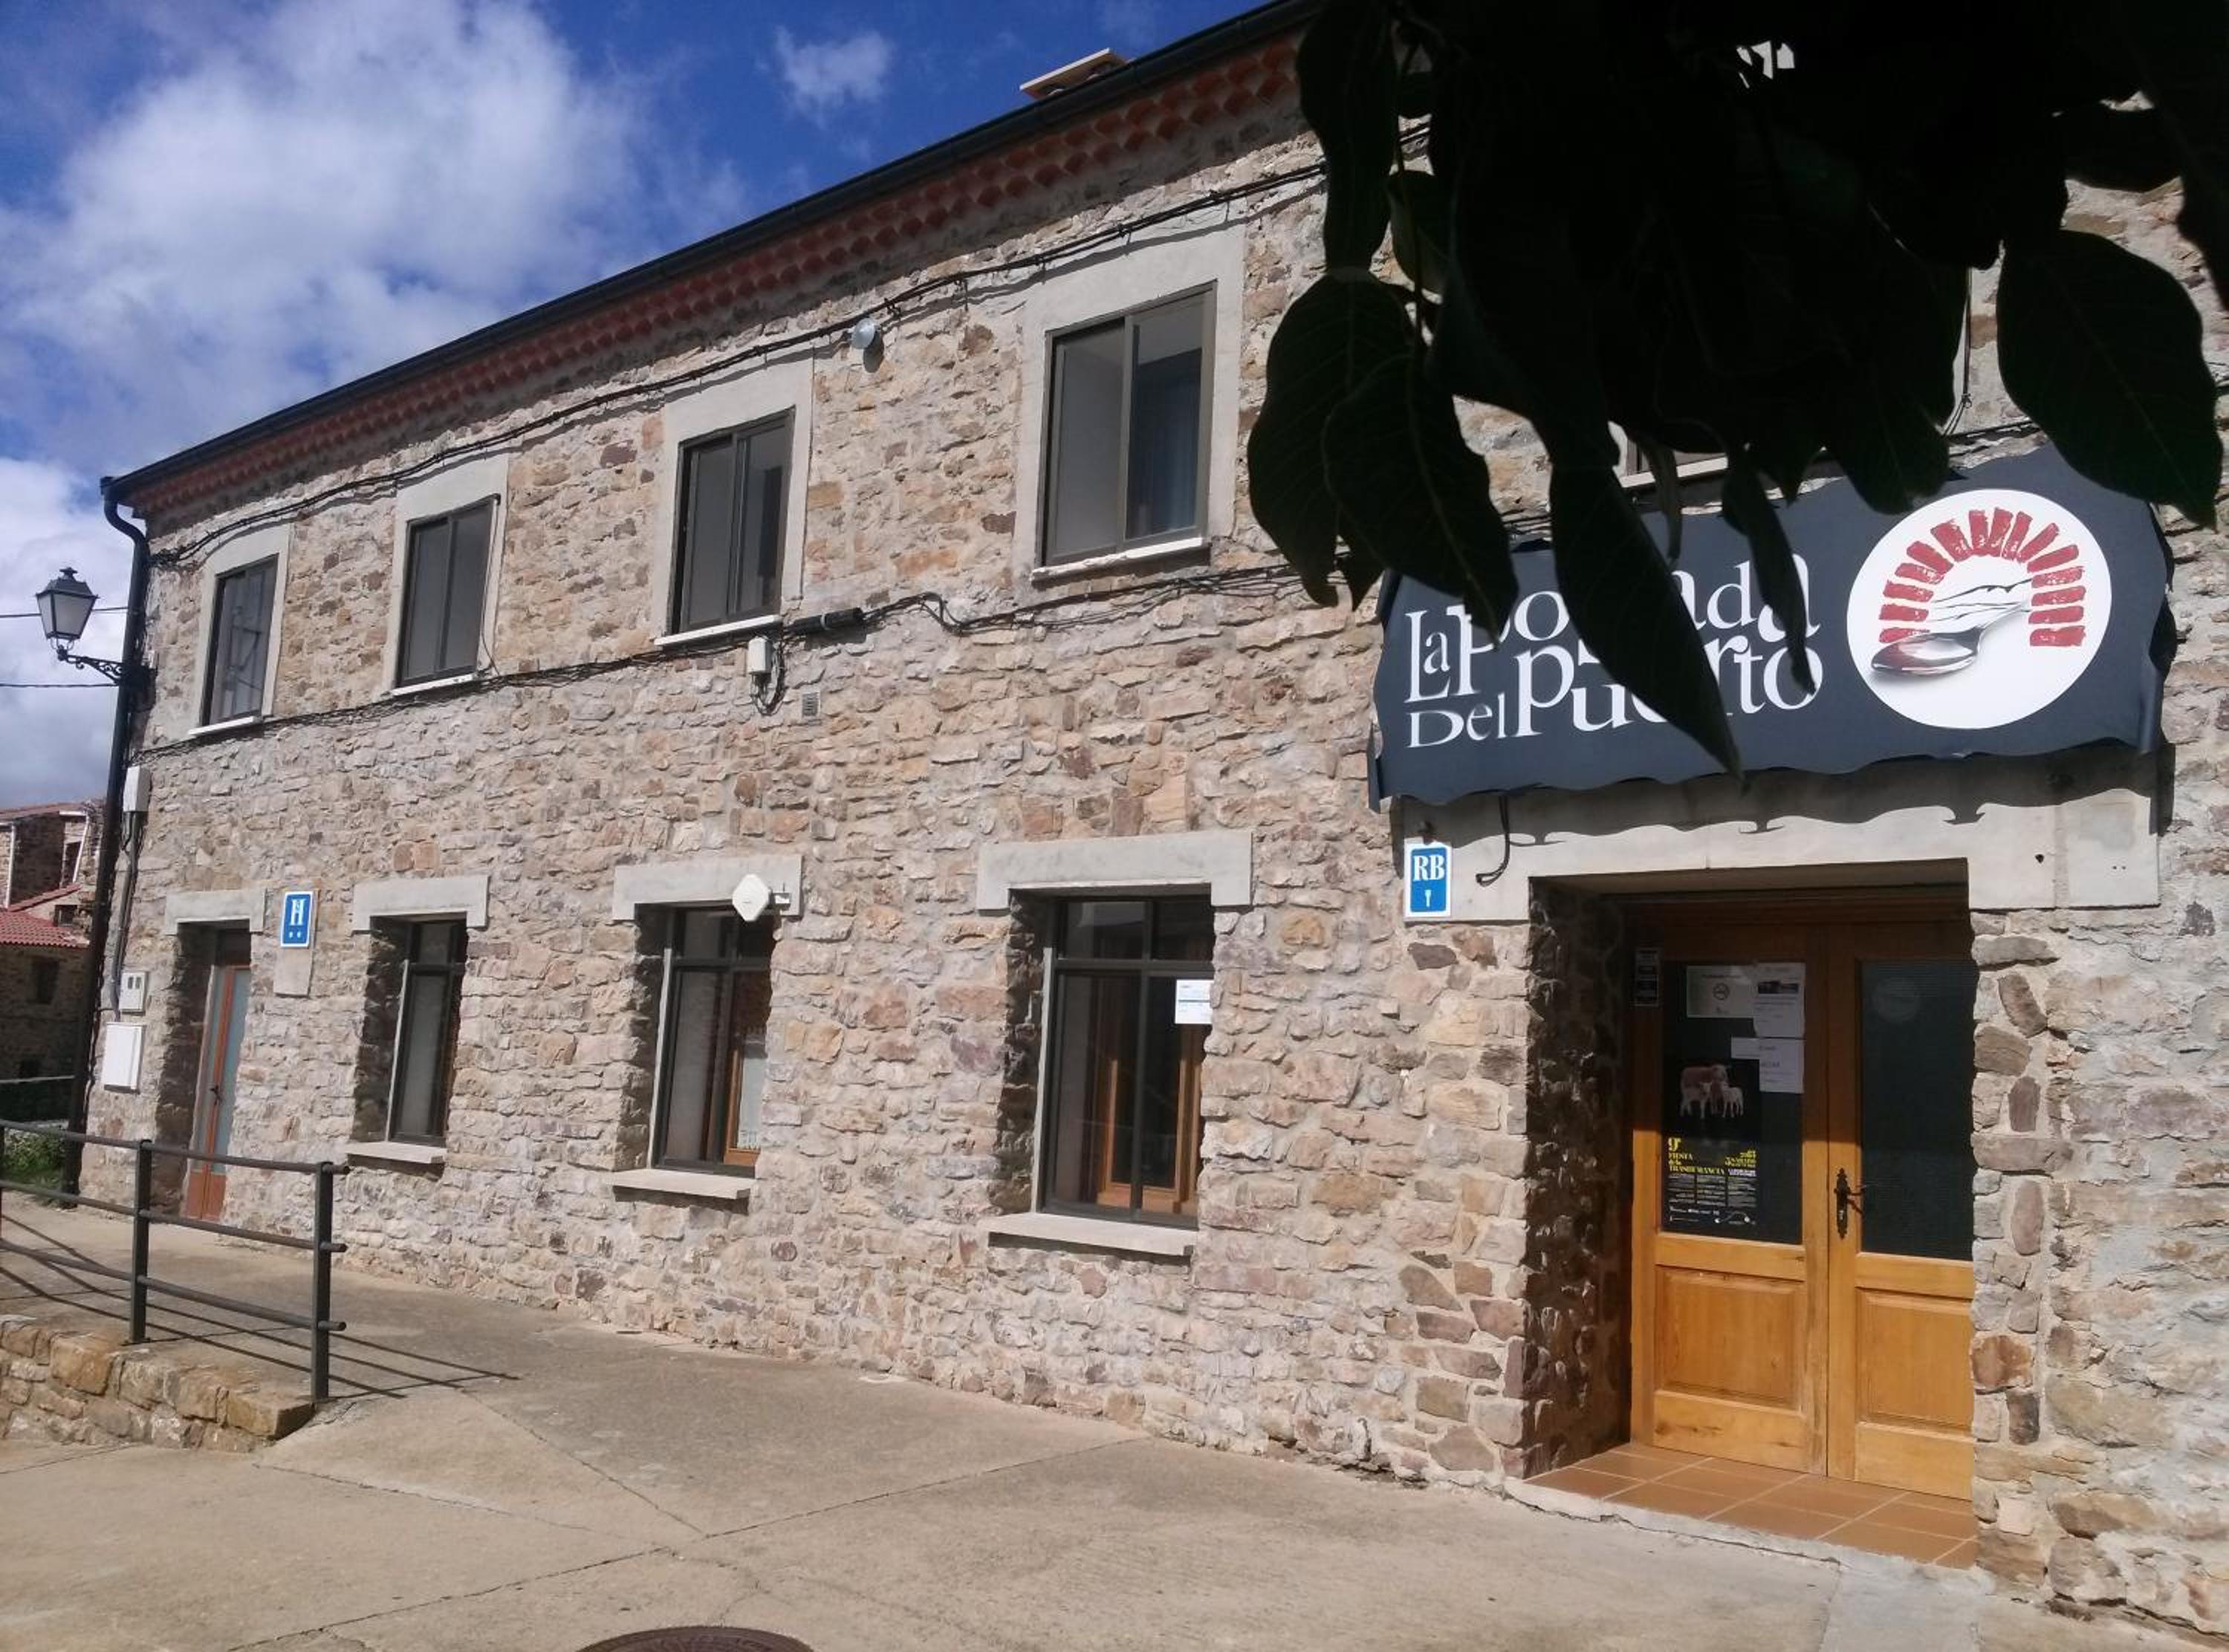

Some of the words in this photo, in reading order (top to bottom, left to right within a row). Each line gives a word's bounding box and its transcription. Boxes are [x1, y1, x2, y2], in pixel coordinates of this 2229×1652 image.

[1404, 611, 1450, 703] La
[1407, 692, 1507, 748] Del
[1513, 634, 1823, 738] Purto
[1413, 855, 1445, 881] RB
